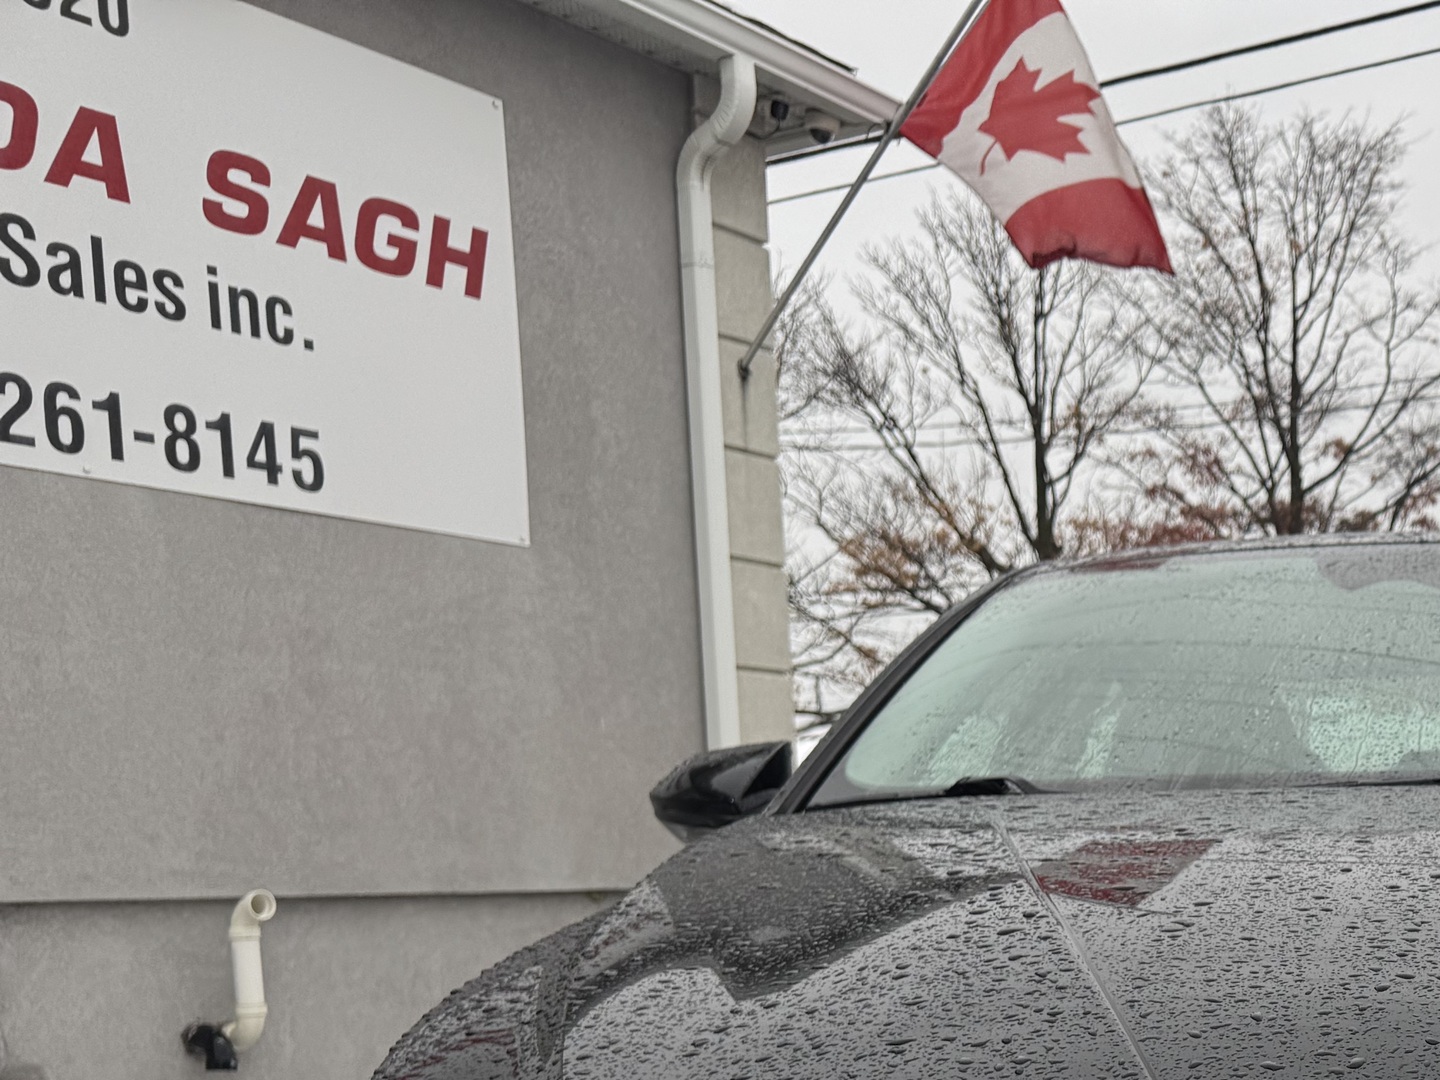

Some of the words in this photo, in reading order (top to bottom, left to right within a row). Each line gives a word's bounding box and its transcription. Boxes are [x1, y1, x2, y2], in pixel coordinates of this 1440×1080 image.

[0, 212, 187, 322] Sales
[206, 265, 314, 351] inc.
[202, 149, 489, 300] SAGH
[0, 372, 325, 493] 261-8145
